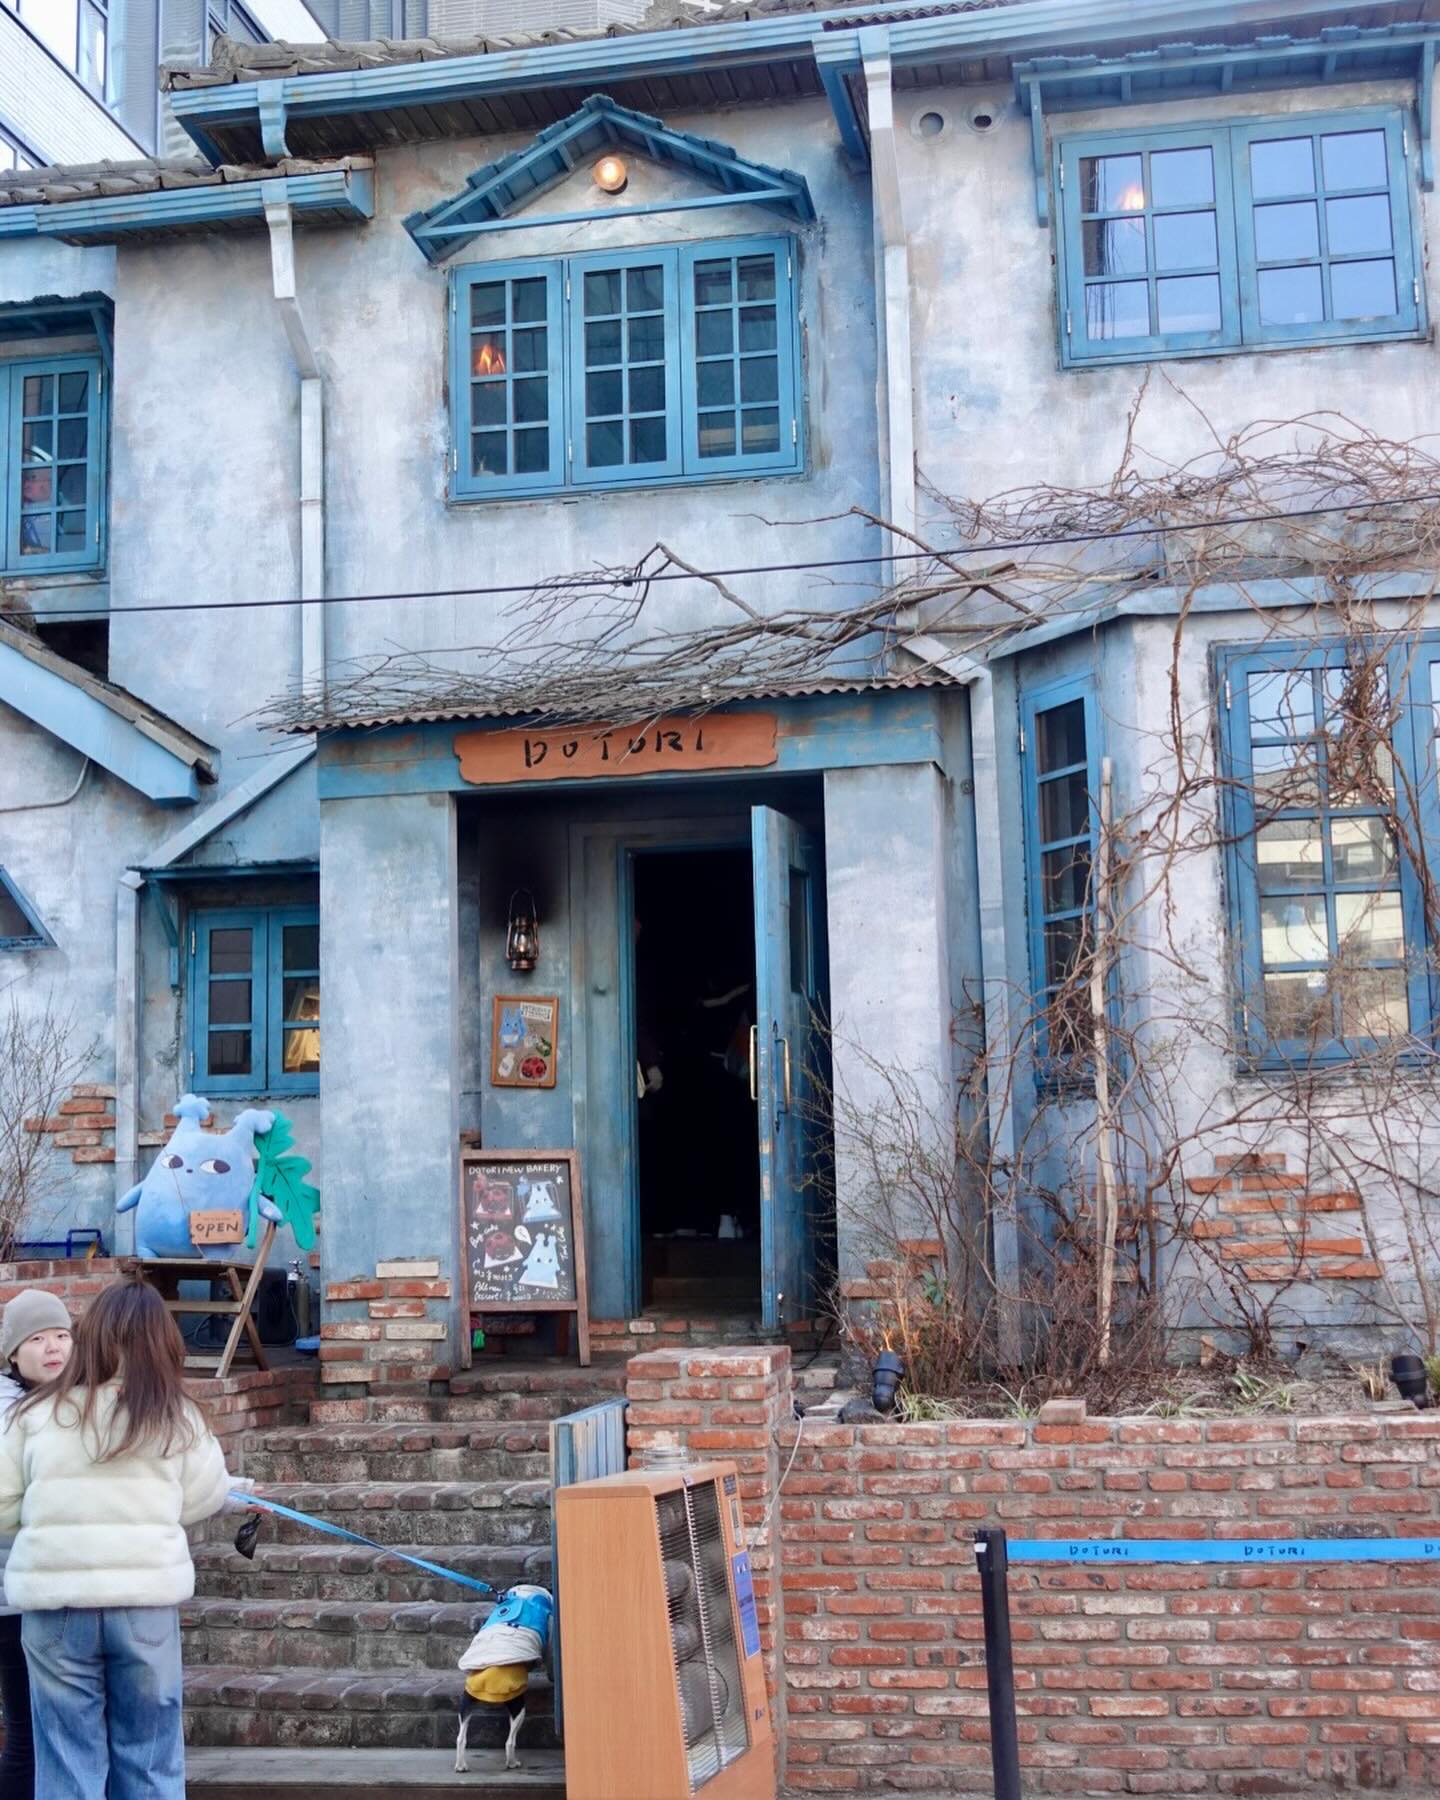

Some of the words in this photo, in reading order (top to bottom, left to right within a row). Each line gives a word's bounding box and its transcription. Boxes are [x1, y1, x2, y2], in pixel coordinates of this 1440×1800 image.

[524, 729, 704, 768] DOTORI
[468, 1166, 500, 1175] DOTORI
[502, 1166, 524, 1175] NEW
[526, 1163, 561, 1174] BAKERY
[195, 1221, 239, 1238] OPEN
[1069, 1545, 1129, 1556] DOTORI
[1244, 1545, 1305, 1557] DOTORI
